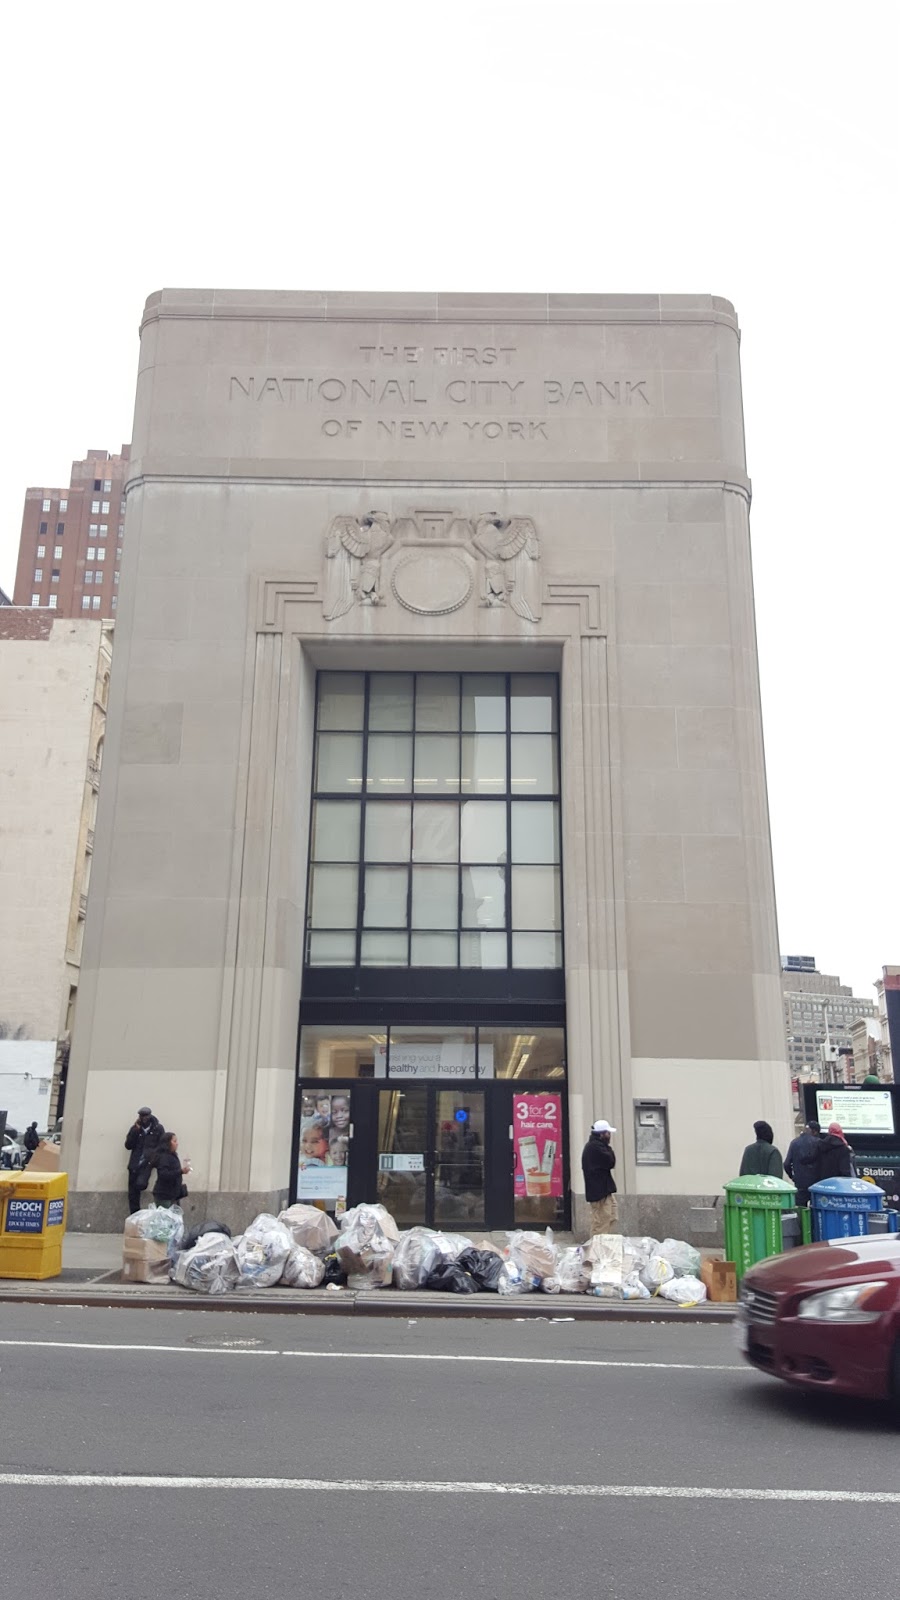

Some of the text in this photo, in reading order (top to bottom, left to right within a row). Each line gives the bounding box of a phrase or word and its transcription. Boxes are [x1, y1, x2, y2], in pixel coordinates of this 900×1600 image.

[359, 346, 517, 365] THE FIRST
[229, 376, 650, 406] NATIONAL CITY BANK
[321, 419, 549, 440] OF NEW YORK
[418, 1055, 433, 1063] you
[420, 1064, 435, 1073] and
[437, 1064, 467, 1075] happy
[516, 1101, 557, 1120] 3 for 2
[520, 1121, 535, 1129] hair
[863, 1168, 895, 1177] Station
[10, 1202, 42, 1211] EPOCH
